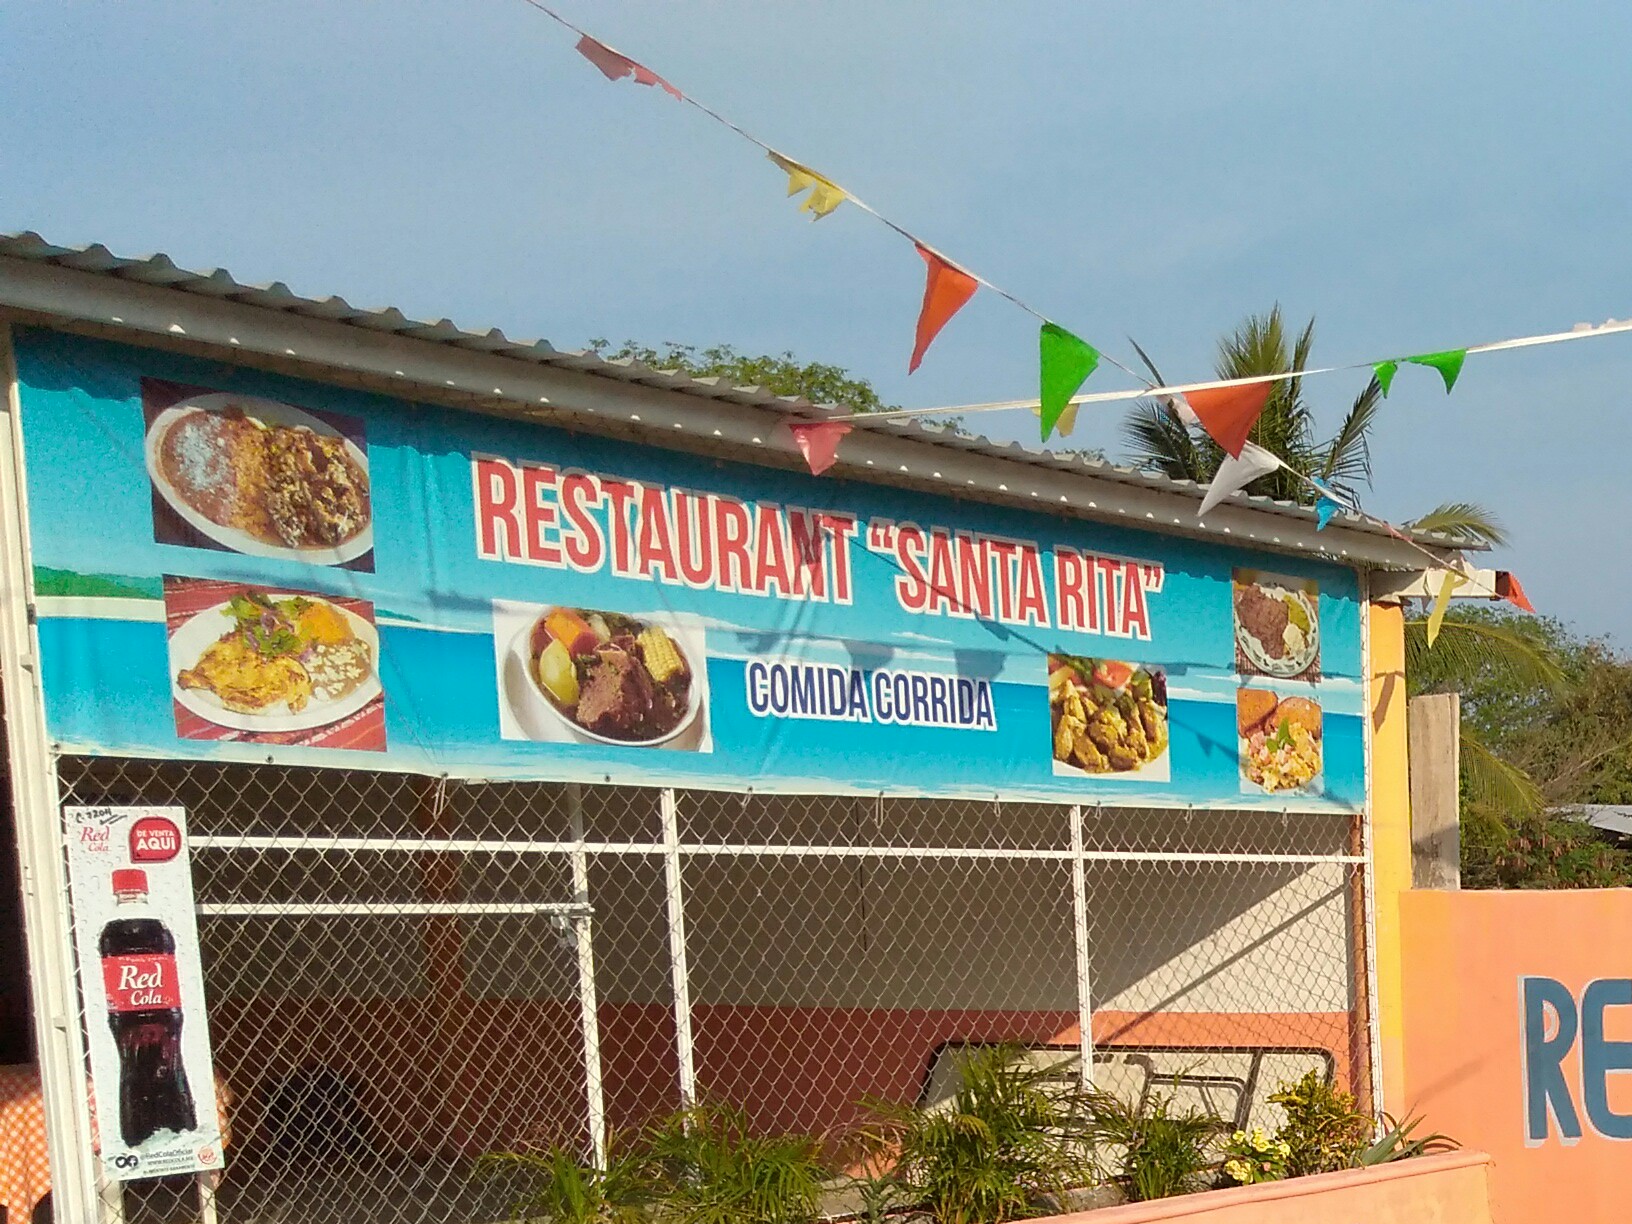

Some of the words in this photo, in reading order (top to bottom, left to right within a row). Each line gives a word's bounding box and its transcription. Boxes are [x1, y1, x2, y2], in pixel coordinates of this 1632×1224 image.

[475, 454, 857, 603] RESTAURANT
[749, 661, 869, 720] COMIDA
[874, 670, 994, 728] CORRIDA
[81, 825, 110, 842] Red
[136, 830, 147, 838] DE
[149, 829, 175, 838] VENTA
[88, 843, 110, 852] Cola
[118, 961, 164, 991] Red
[130, 989, 163, 1006] Cola
